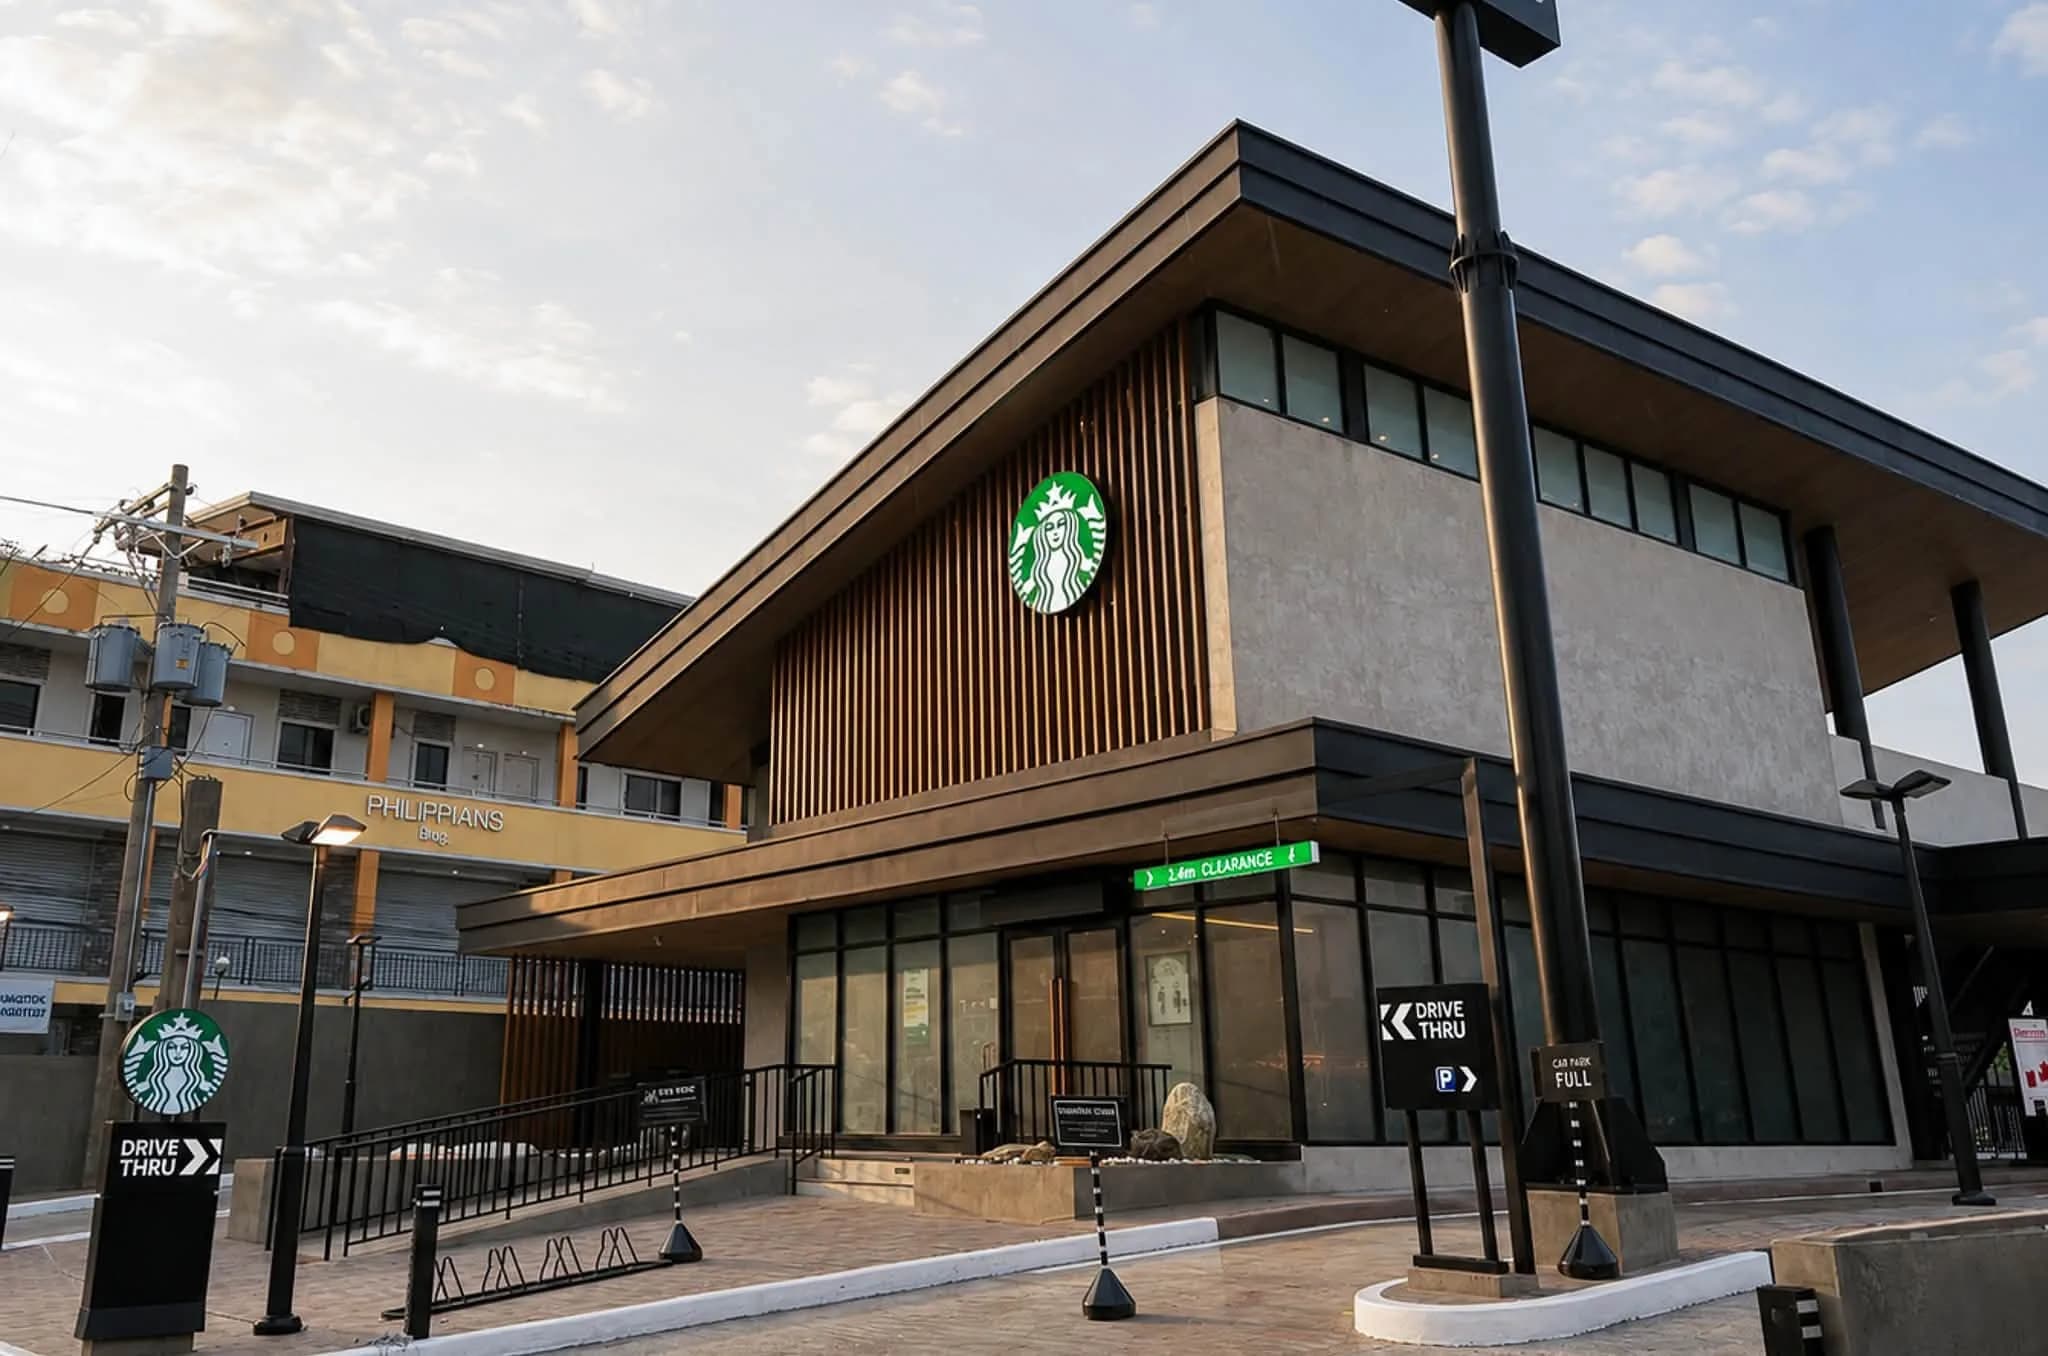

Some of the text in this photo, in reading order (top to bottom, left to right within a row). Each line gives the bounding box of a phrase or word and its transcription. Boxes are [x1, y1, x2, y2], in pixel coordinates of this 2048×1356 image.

[367, 794, 504, 831] PHILIPPIANS
[1415, 1000, 1465, 1018] DRIVE
[1418, 1020, 1466, 1039] THRU
[1439, 1069, 1453, 1089] P
[1555, 1070, 1592, 1088] FULL
[121, 1138, 180, 1156] DRIVE
[120, 1158, 177, 1176] THRU
